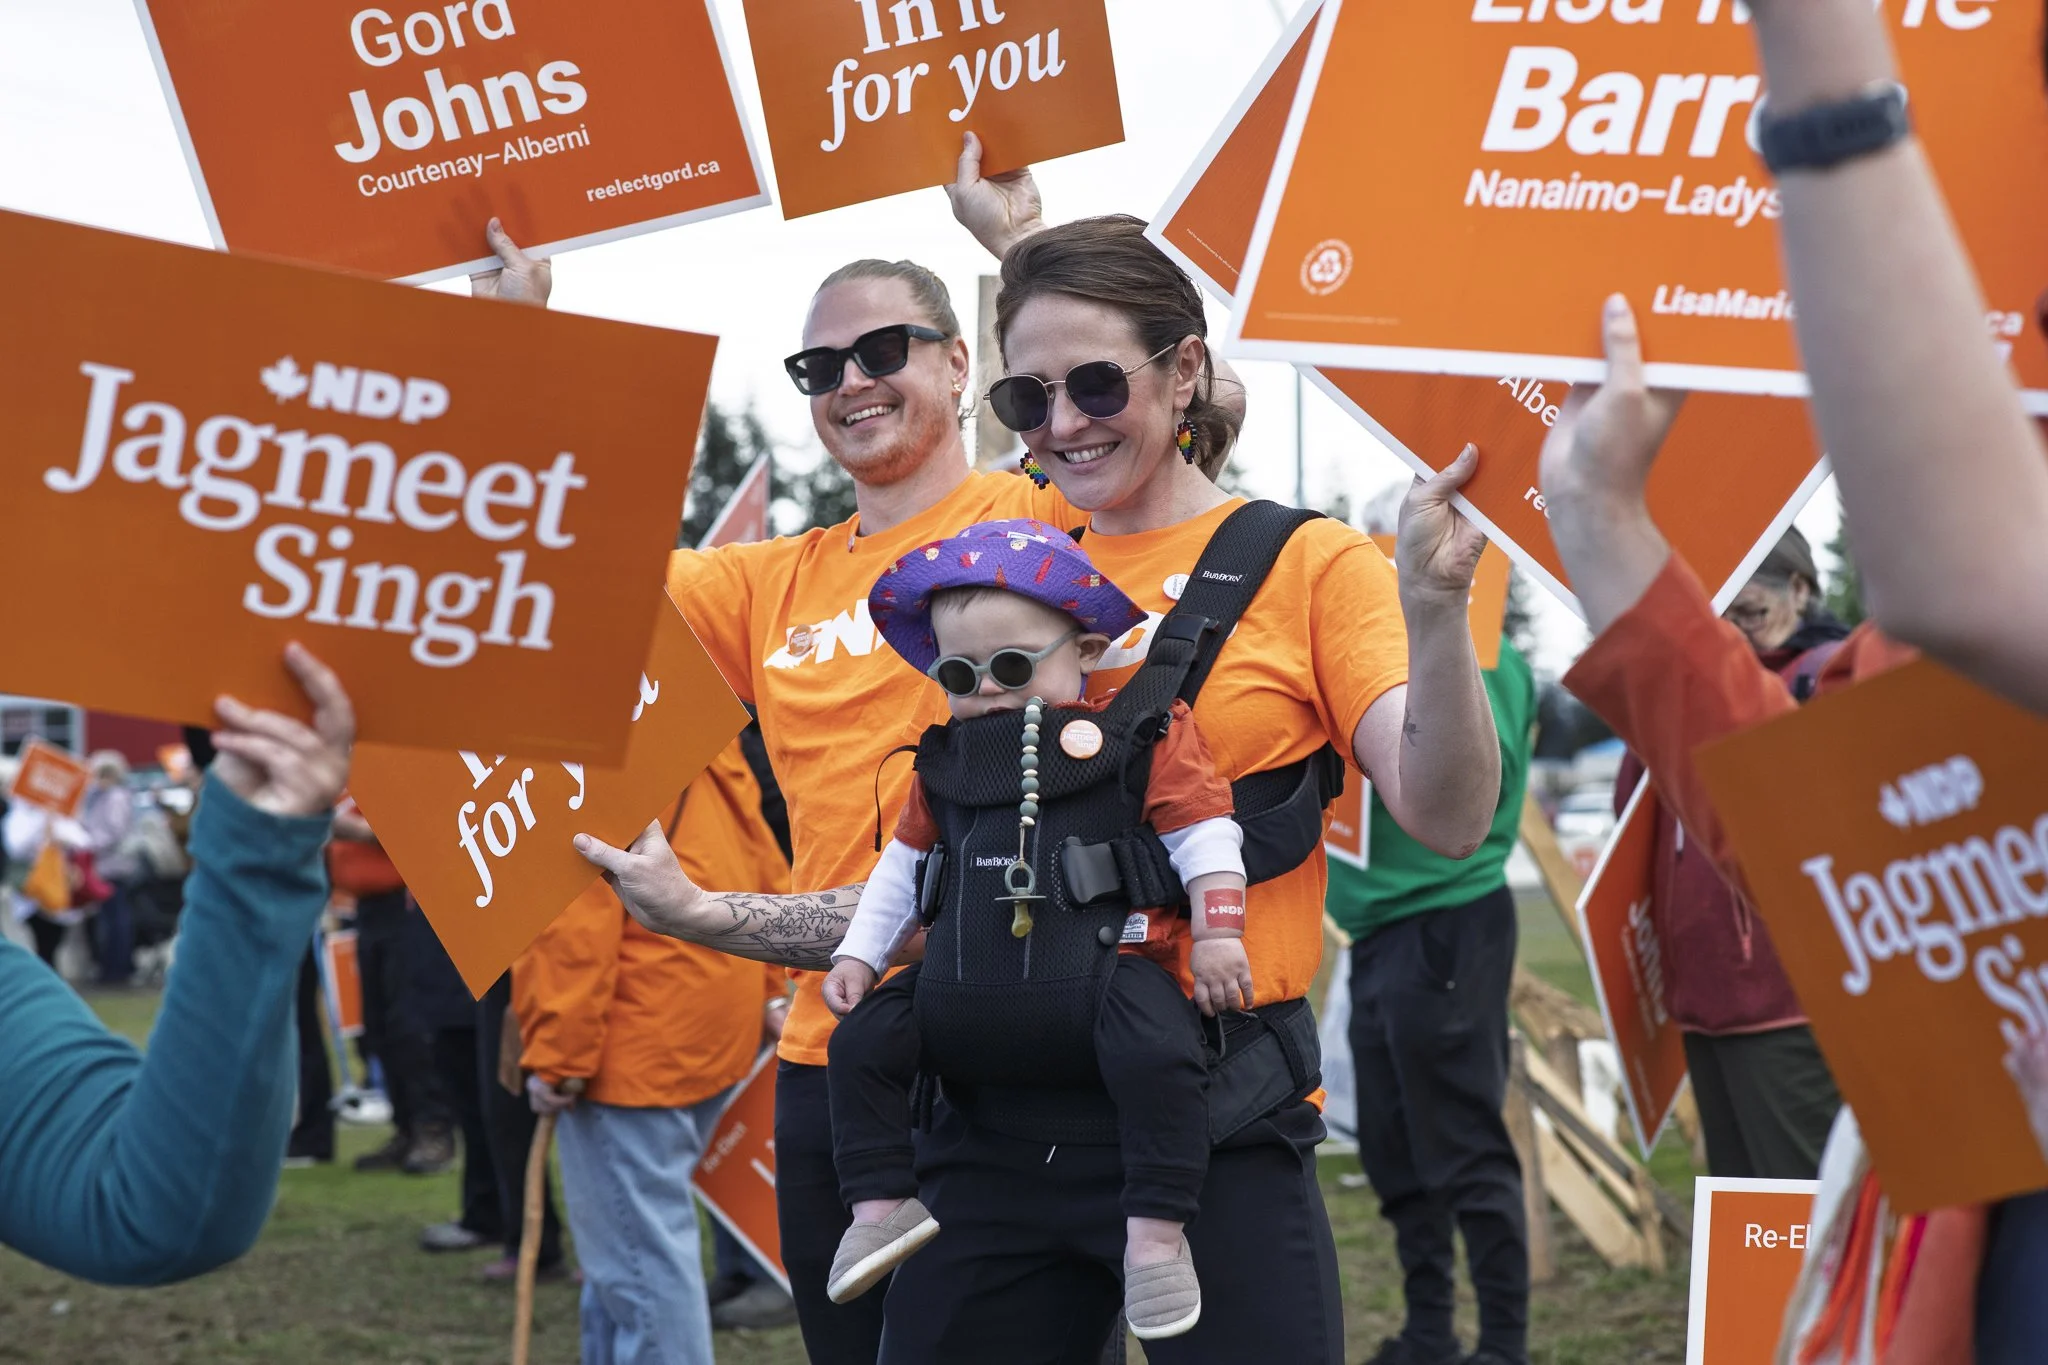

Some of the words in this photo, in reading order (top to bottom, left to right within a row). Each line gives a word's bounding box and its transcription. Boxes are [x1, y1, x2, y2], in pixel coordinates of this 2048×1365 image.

[335, 60, 588, 163] Johns
[820, 58, 929, 152] for
[948, 28, 1066, 122] you
[1481, 46, 1768, 157] Barr
[586, 160, 721, 202] reelectgord.ca
[307, 361, 450, 425] NDP
[44, 361, 586, 549] Jagmeet
[243, 524, 554, 668] Singh
[457, 767, 537, 908] for
[1218, 905, 1245, 916] NDP
